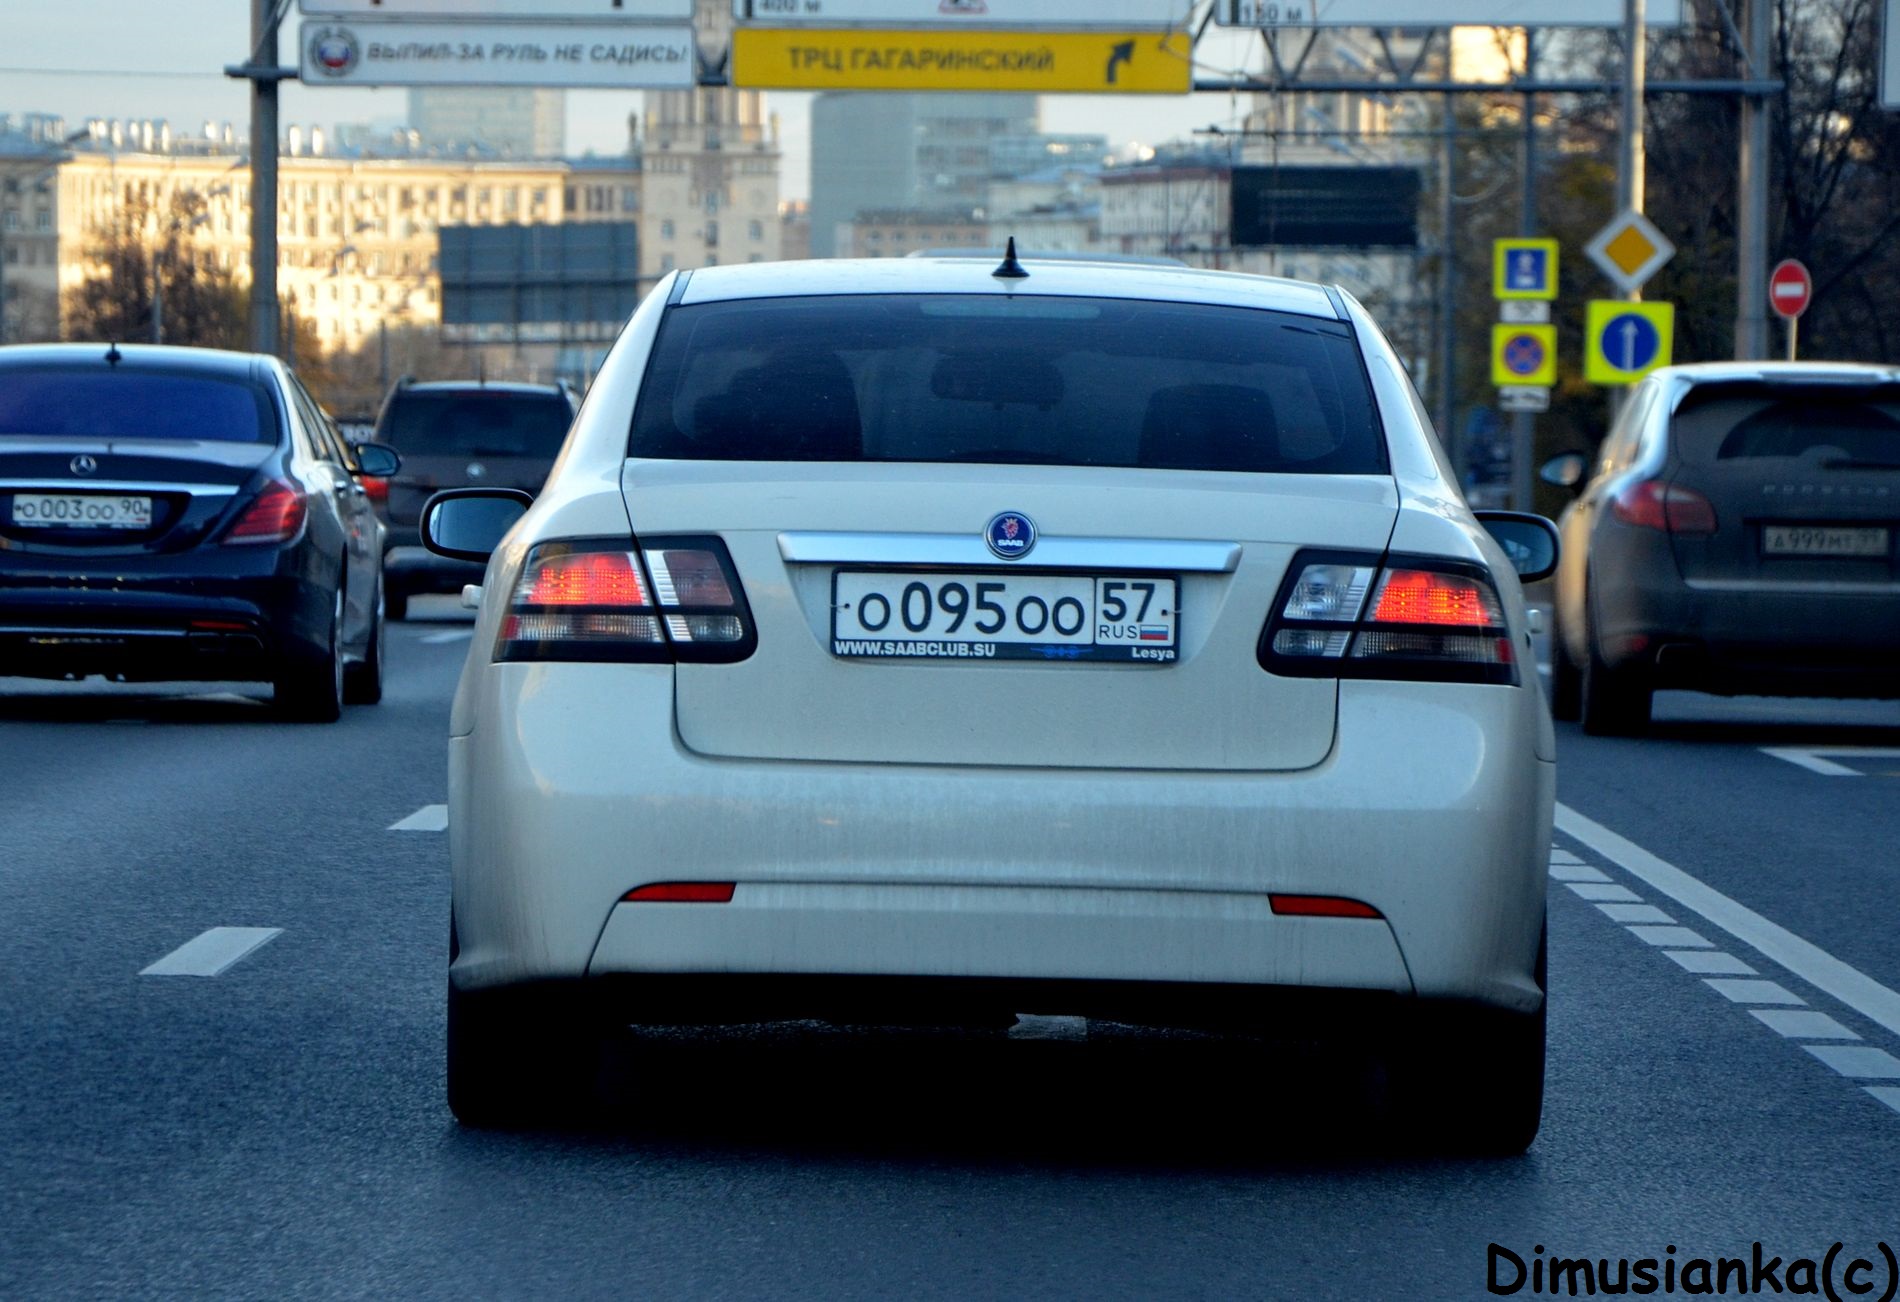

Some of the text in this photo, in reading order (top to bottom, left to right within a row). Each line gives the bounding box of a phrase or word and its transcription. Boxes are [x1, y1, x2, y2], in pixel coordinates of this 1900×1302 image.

[491, 43, 548, 62] РУЛЬ
[554, 44, 583, 61] НЕ
[590, 44, 687, 65] САДИСЬ!
[789, 46, 1054, 72] ТРЦ ГАГАРИНСКИЙ
[1102, 582, 1156, 622] 57
[1099, 625, 1137, 639] RUS
[835, 641, 996, 657] WWW.SAABCLUB.SU
[1131, 647, 1176, 661] Lesya
